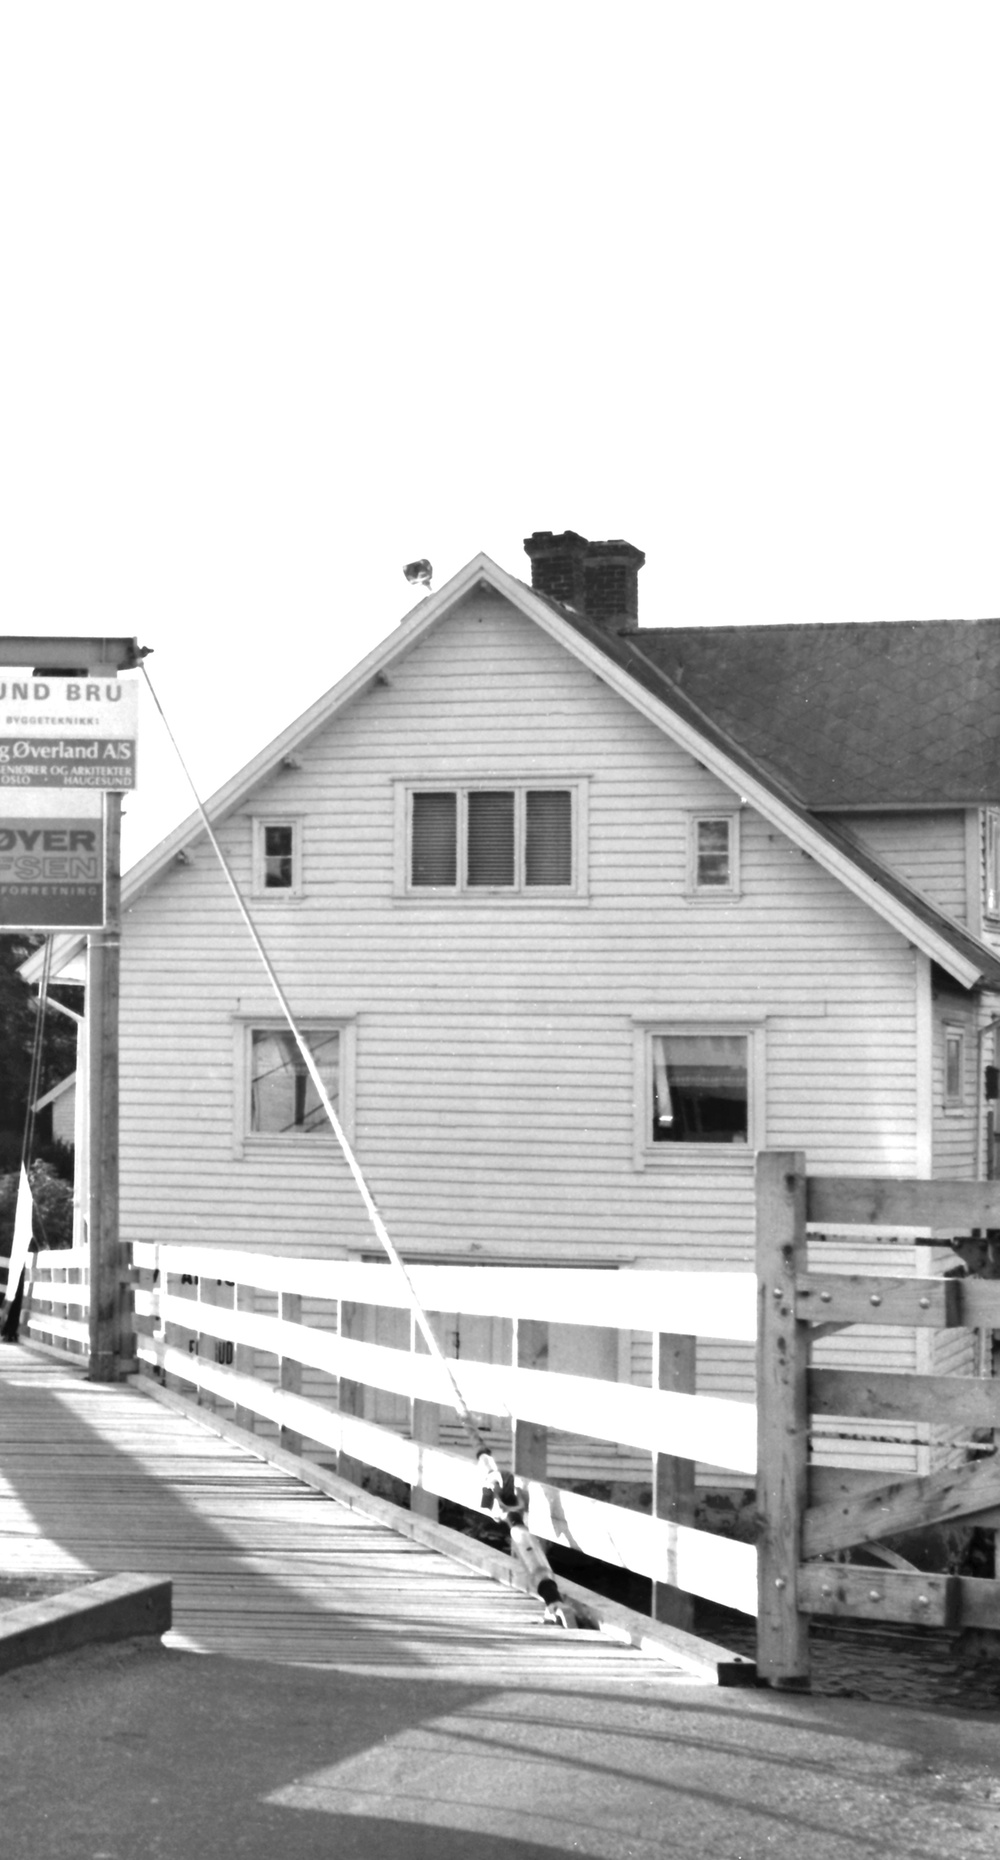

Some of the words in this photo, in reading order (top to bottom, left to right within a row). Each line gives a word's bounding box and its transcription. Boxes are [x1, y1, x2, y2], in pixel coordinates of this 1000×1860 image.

[66, 684, 123, 702] BRU
[12, 740, 99, 760] Øverland
[50, 765, 70, 776] OG
[70, 765, 133, 776] ARKITEKTER
[1, 775, 31, 786] OSLO
[63, 776, 132, 786] HAUGESUND
